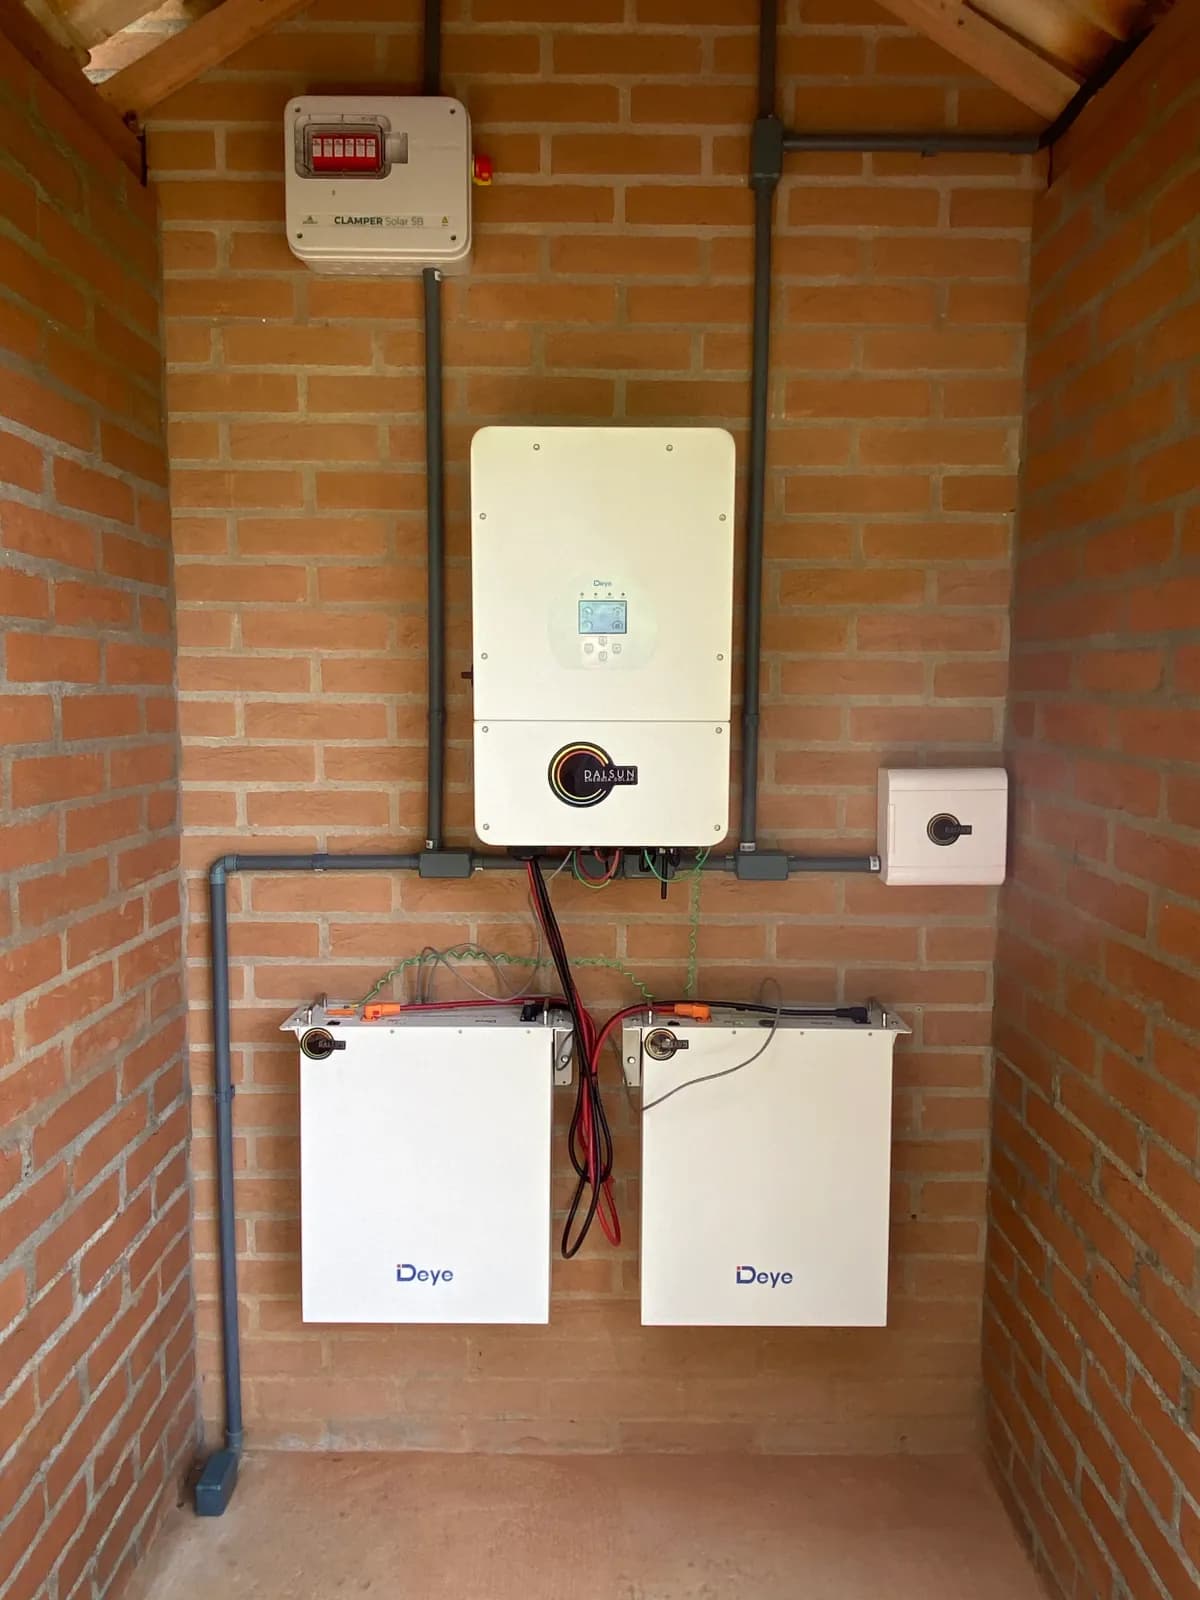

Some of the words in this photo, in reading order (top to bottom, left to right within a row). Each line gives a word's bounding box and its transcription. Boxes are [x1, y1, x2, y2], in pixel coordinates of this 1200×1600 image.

[334, 215, 383, 225] CLAMPER
[385, 216, 408, 226] Solar
[584, 769, 635, 779] DALSUN
[396, 1263, 454, 1286] Deye
[736, 1265, 793, 1288] Deye
